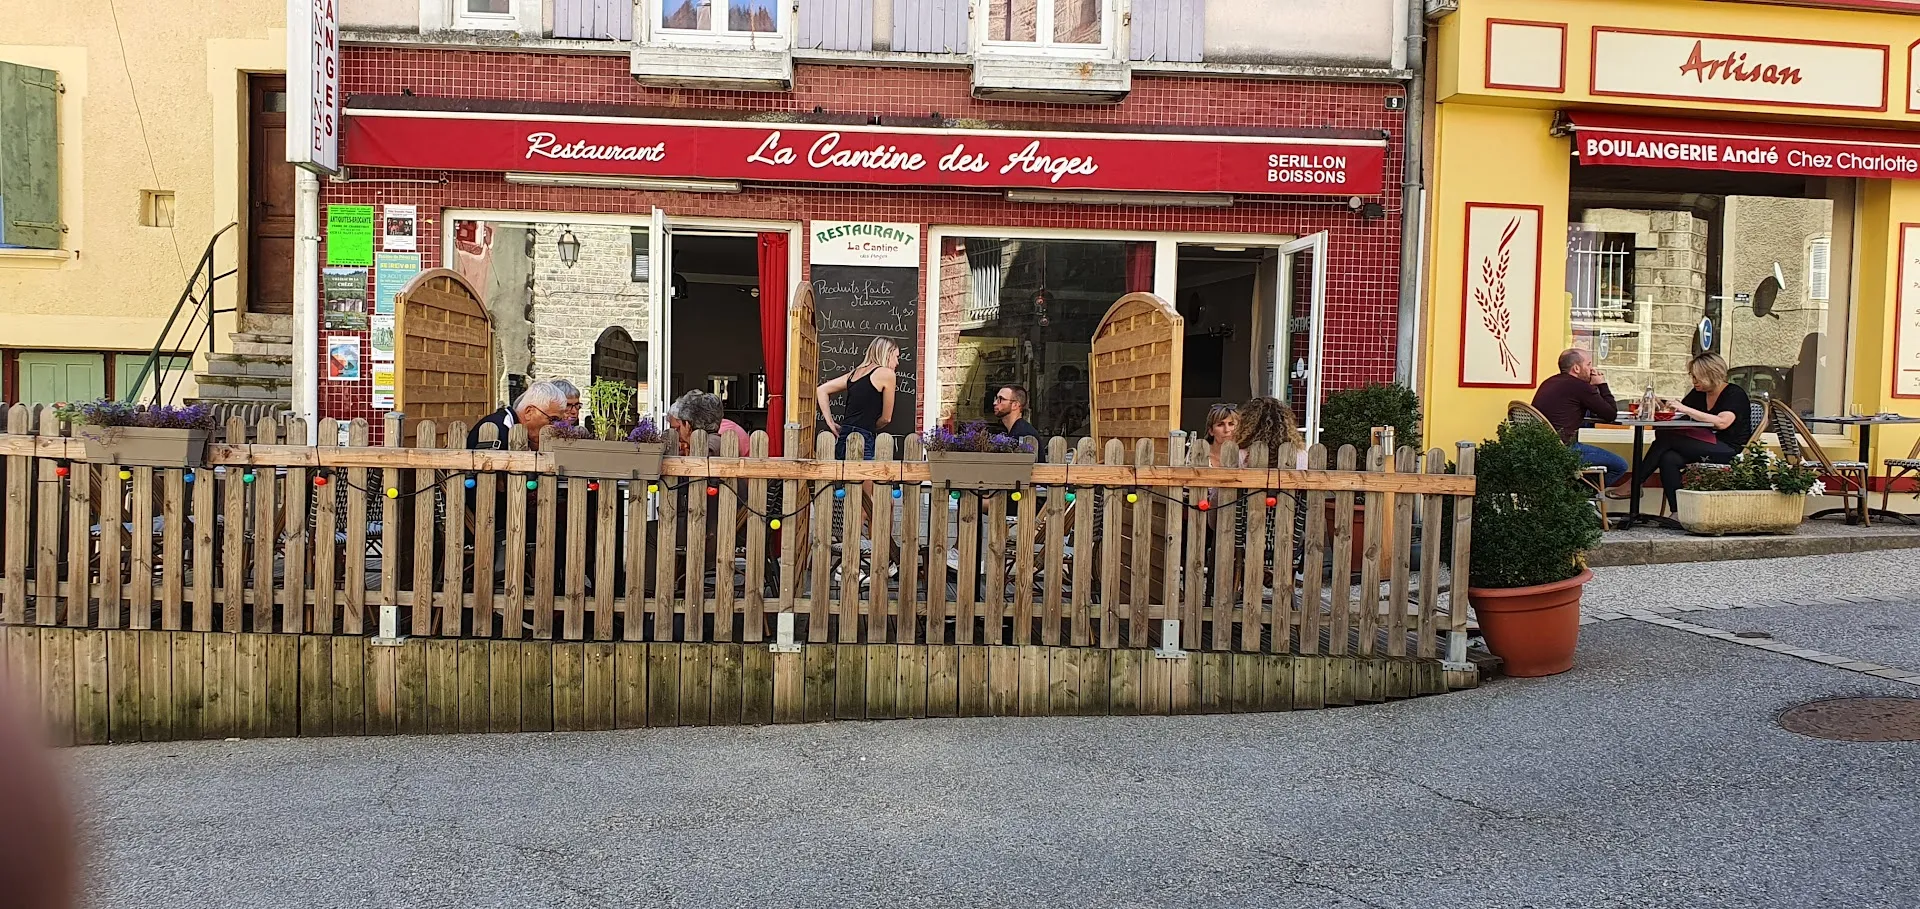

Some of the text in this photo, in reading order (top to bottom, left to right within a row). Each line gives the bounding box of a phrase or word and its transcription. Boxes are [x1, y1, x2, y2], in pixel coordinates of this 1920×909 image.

[325, 0, 334, 137] ANGES
[1679, 39, 1803, 85] Artisan
[1391, 97, 1398, 108] 9
[525, 131, 665, 162] Restaurant
[1587, 139, 1918, 173] BOULANGERIE André Chez Charlotte
[746, 131, 1098, 184] La Cantine des Anges
[1268, 154, 1346, 169] SERILLON
[1267, 169, 1346, 184] BOISSONS
[816, 223, 914, 246] RESTAURANT
[847, 241, 899, 253] La Cantine
[813, 279, 892, 300] Produits faits
[816, 310, 908, 332] Menu ce midi
[820, 339, 859, 356] Salade
[819, 358, 847, 372] Dos
